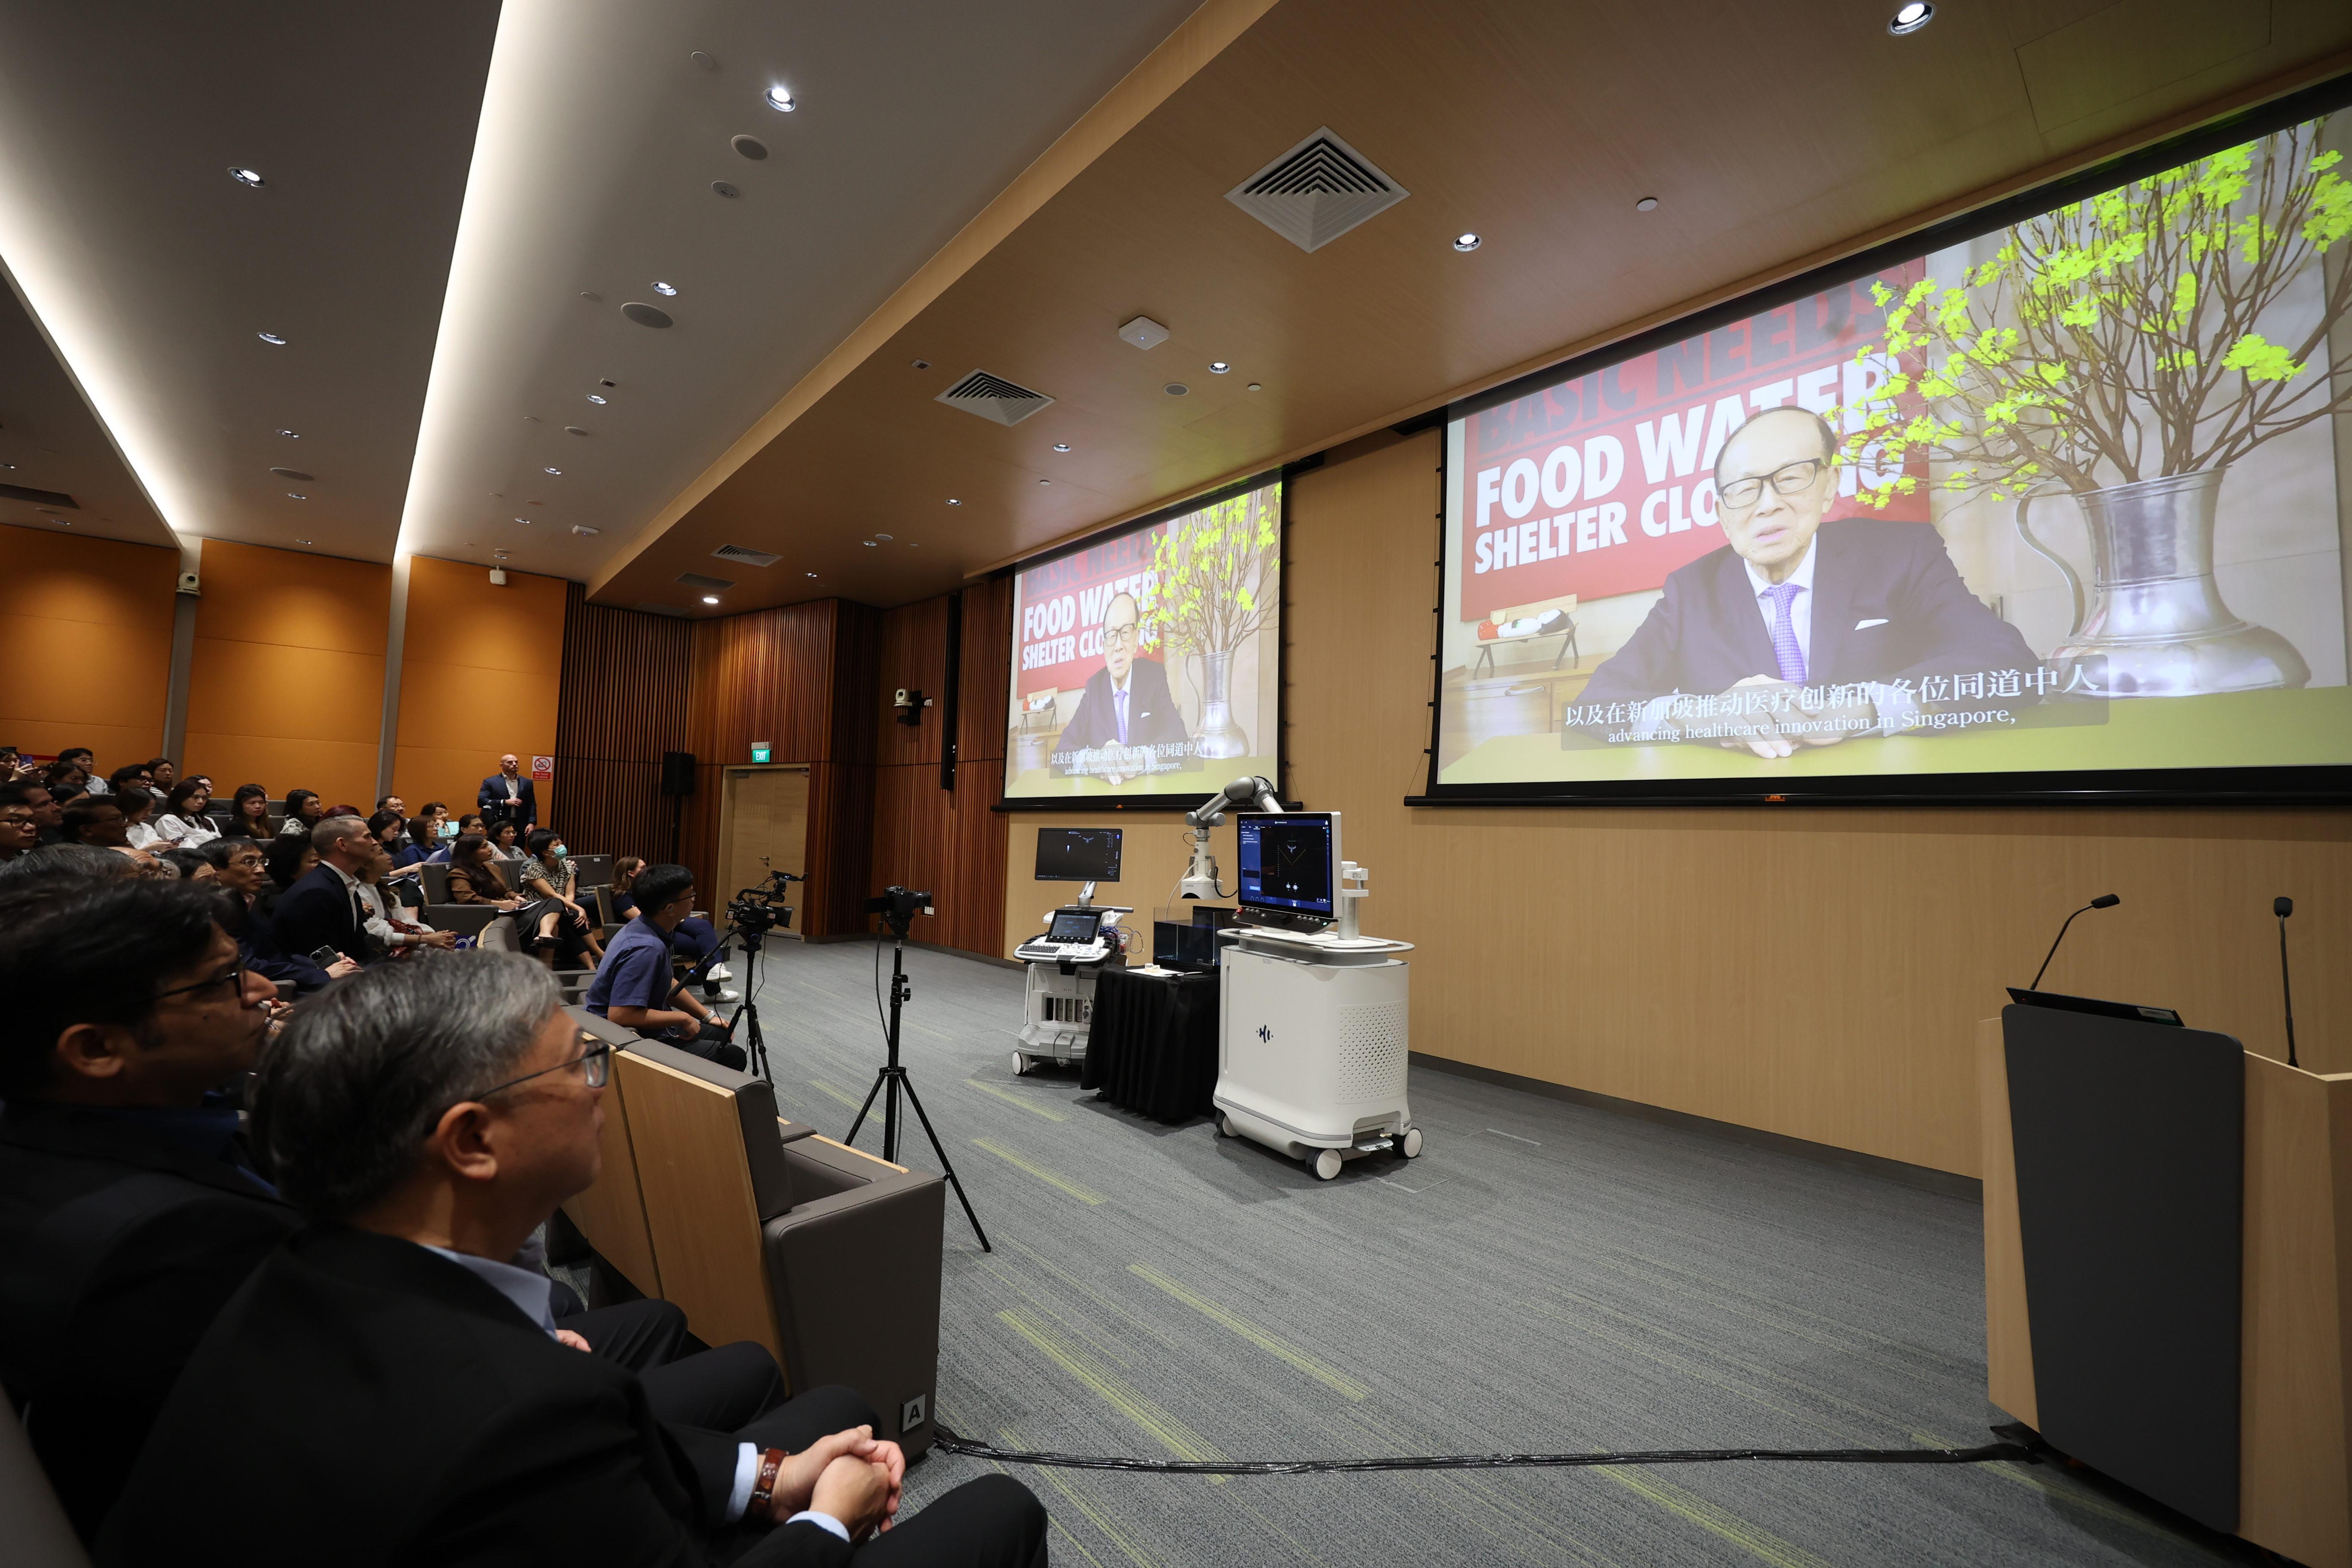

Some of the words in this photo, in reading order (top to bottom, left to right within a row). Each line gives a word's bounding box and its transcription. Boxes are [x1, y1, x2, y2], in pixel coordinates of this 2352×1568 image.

[1479, 363, 1637, 454] BASIC
[1476, 435, 1625, 528] FOOD
[1475, 501, 1628, 574] SHELTER
[1023, 595, 1075, 642] FOOD
[1022, 635, 1075, 671] SHELTER
[1565, 664, 2101, 727] 以及在新加坡推动医疗创新的各位同道中人
[1608, 727, 1681, 743] advancing
[1685, 721, 1770, 738] healthcare
[1775, 712, 1871, 734] innovation
[1877, 712, 1895, 729] in
[1901, 710, 2016, 730] Singapore,
[756, 752, 766, 760] EXIT
[1051, 741, 1203, 765] 以及在新加坡推动医疗创新的各位同道中人
[1065, 765, 1088, 775] advancing
[1089, 764, 1115, 774] healthcare
[1116, 763, 1144, 772] innovation
[1152, 762, 1182, 772] Singapore,
[908, 1404, 921, 1424] A
